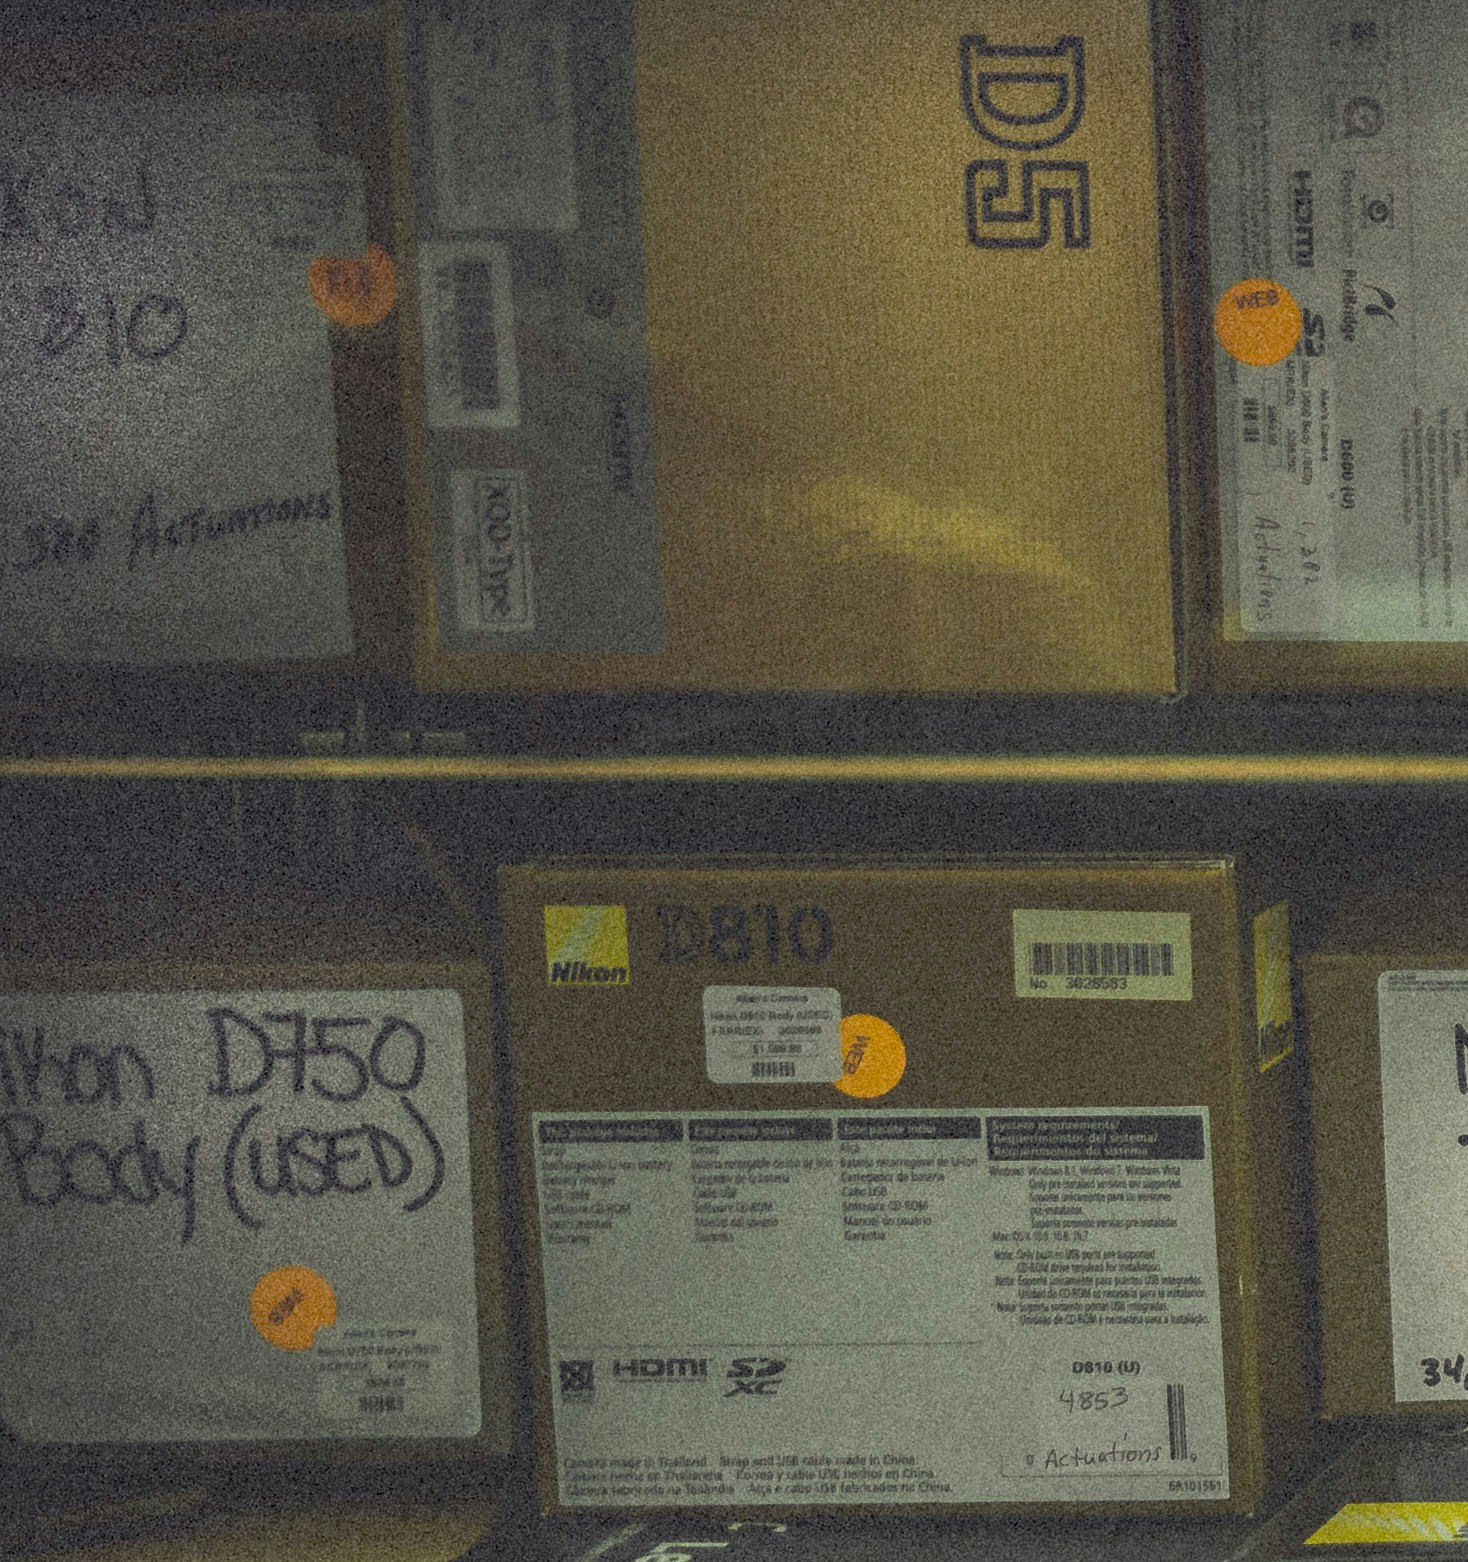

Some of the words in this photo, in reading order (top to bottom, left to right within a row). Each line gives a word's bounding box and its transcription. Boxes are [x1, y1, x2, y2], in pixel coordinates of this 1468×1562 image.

[959, 34, 1091, 251] D5
[655, 904, 836, 965] D810
[550, 960, 626, 983] Nikon
[0, 1110, 201, 1248] Body
[224, 1098, 444, 1232] (USED)
[1057, 1385, 1130, 1412] 4853
